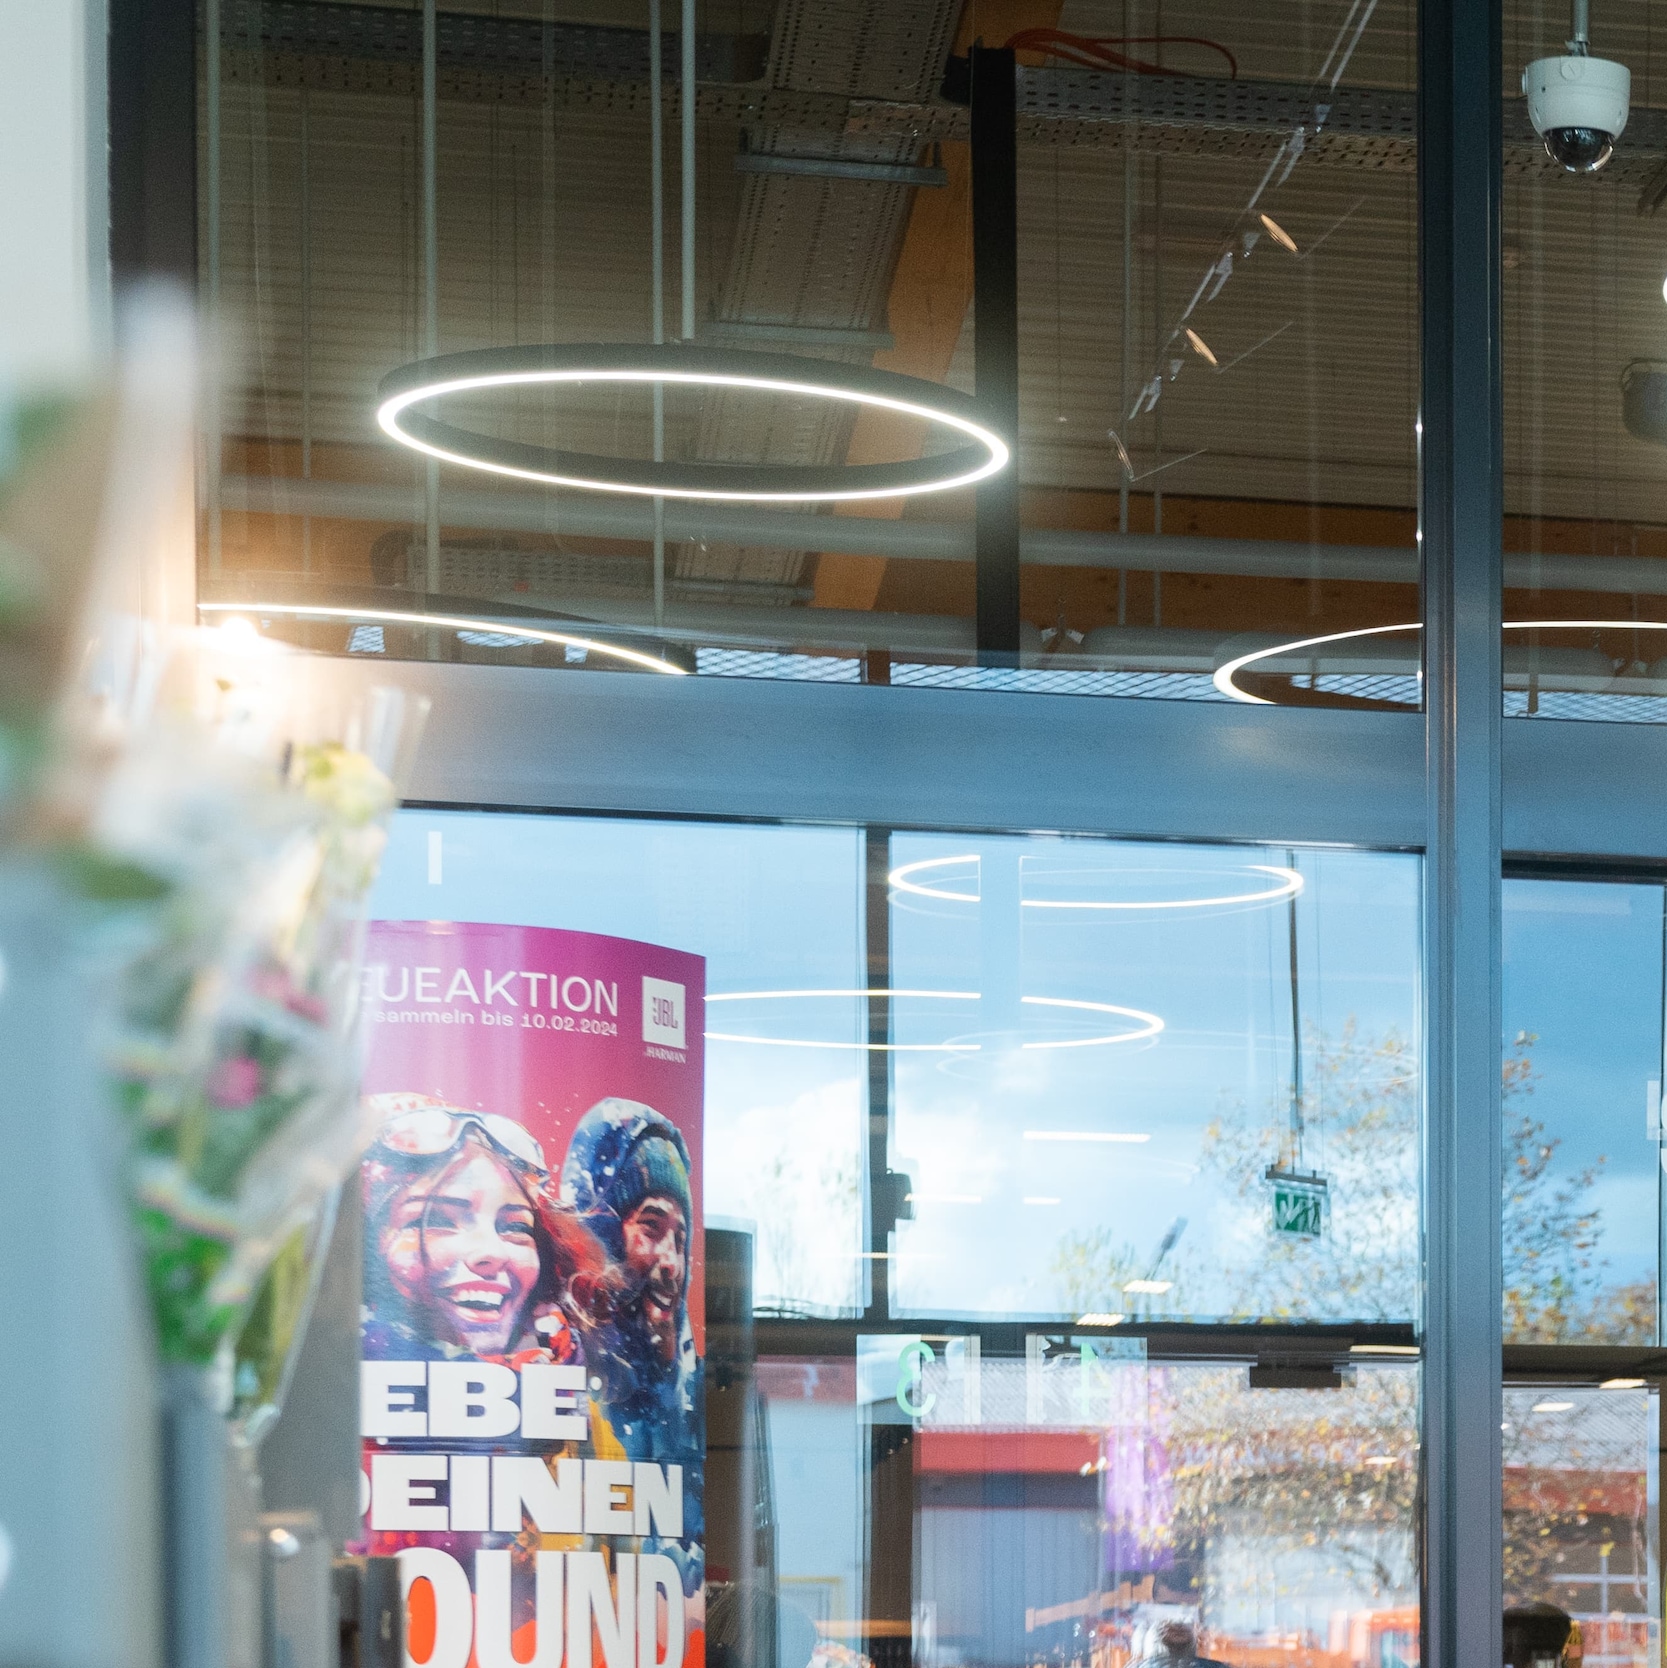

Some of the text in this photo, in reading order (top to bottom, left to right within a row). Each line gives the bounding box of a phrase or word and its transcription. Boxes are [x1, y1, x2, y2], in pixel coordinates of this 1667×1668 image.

[375, 1007, 618, 1037] sammeln bis 10.02.2024
[360, 1361, 588, 1441] EBE
[361, 1454, 684, 1539] EINEN
